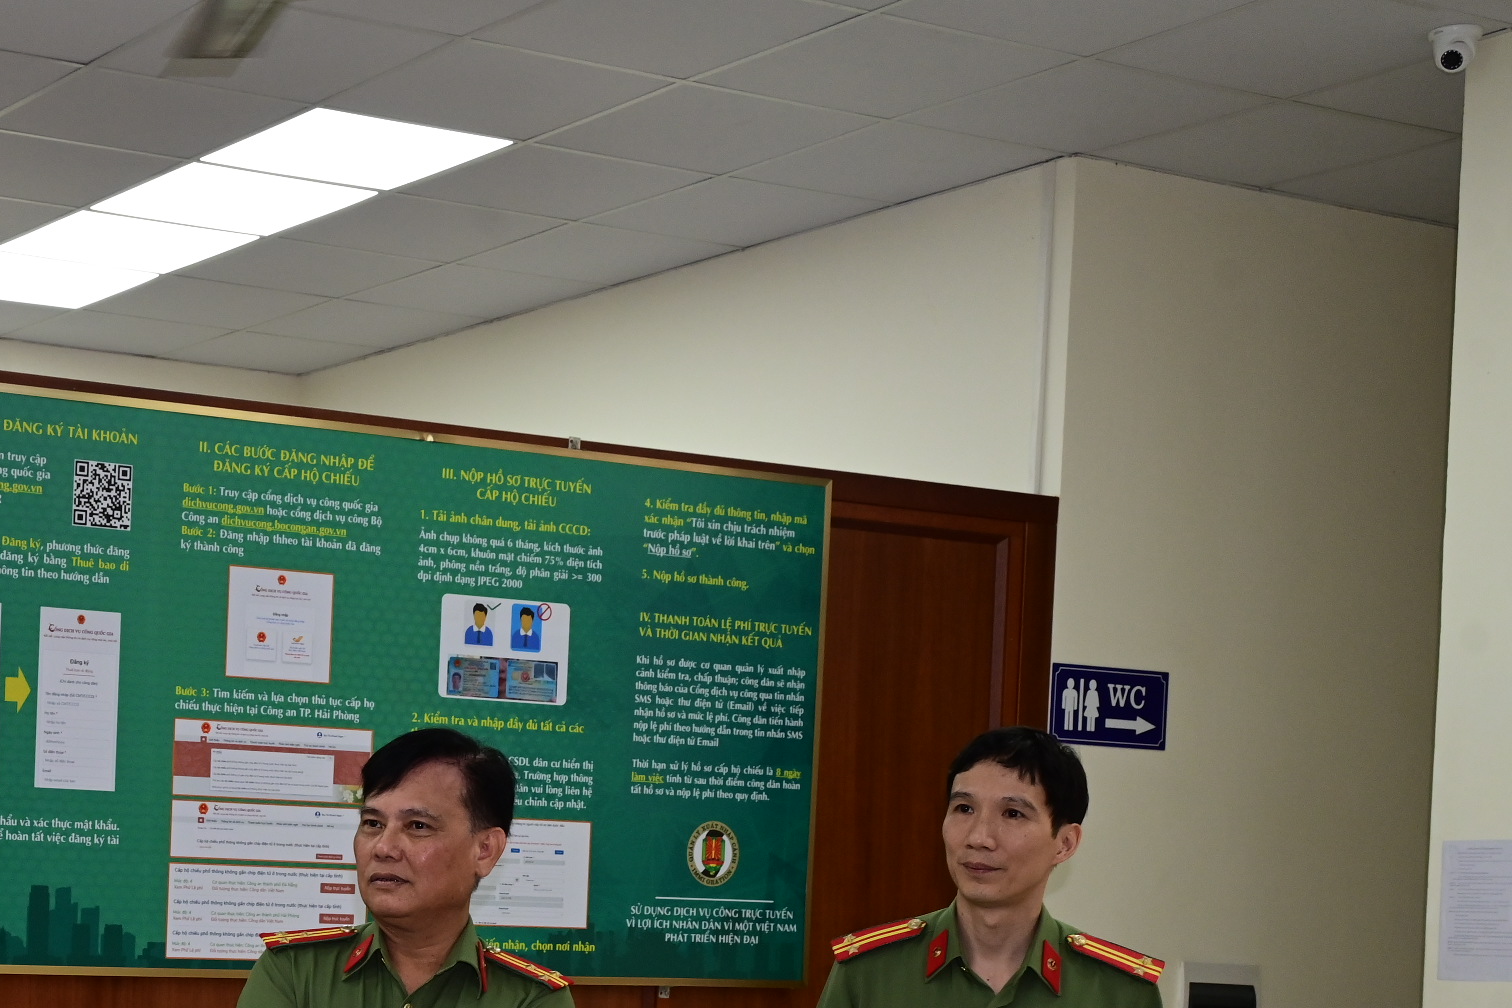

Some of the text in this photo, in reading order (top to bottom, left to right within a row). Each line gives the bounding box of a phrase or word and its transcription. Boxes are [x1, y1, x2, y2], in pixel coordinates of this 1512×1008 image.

[3, 418, 42, 434] ĐĂNG
[46, 422, 63, 436] KÝ
[68, 424, 88, 439] TÀI
[92, 428, 138, 444] KHOẢN
[199, 441, 375, 470] II. CÁC BƯỚC ĐĂNG NHẬP ĐỂ
[214, 459, 360, 485] ĐĂNG KÝ CẤP HỘ CHIẾU
[442, 468, 592, 493] III. NỘP HỒ SƠ TRỰC TUYẾN
[476, 486, 557, 507] CẤP HỘ CHIẾU
[181, 512, 205, 526] Công
[221, 516, 347, 536] dichvucong.bocongan.gov.vn
[417, 571, 523, 588] dpi định dạng JPEG 2000
[640, 612, 812, 636] IV. THANH TOÁN LỆ PHÍ TRỰC TUYẾN
[639, 625, 783, 649] VÀ THỜI GIAN NHẬN KẾT QUẢ
[1107, 683, 1146, 709] WC
[630, 904, 794, 920] SỬ DỤNG DỊCH VỤ CÔNG TRỰC TUYẾN
[626, 917, 797, 933] VÌ LỢI ÍCH NHÂN DÂN VÌ MỘT VIỆT NAM
[665, 931, 759, 946] PHÁT TRIỂN HIỆN ĐẠI
